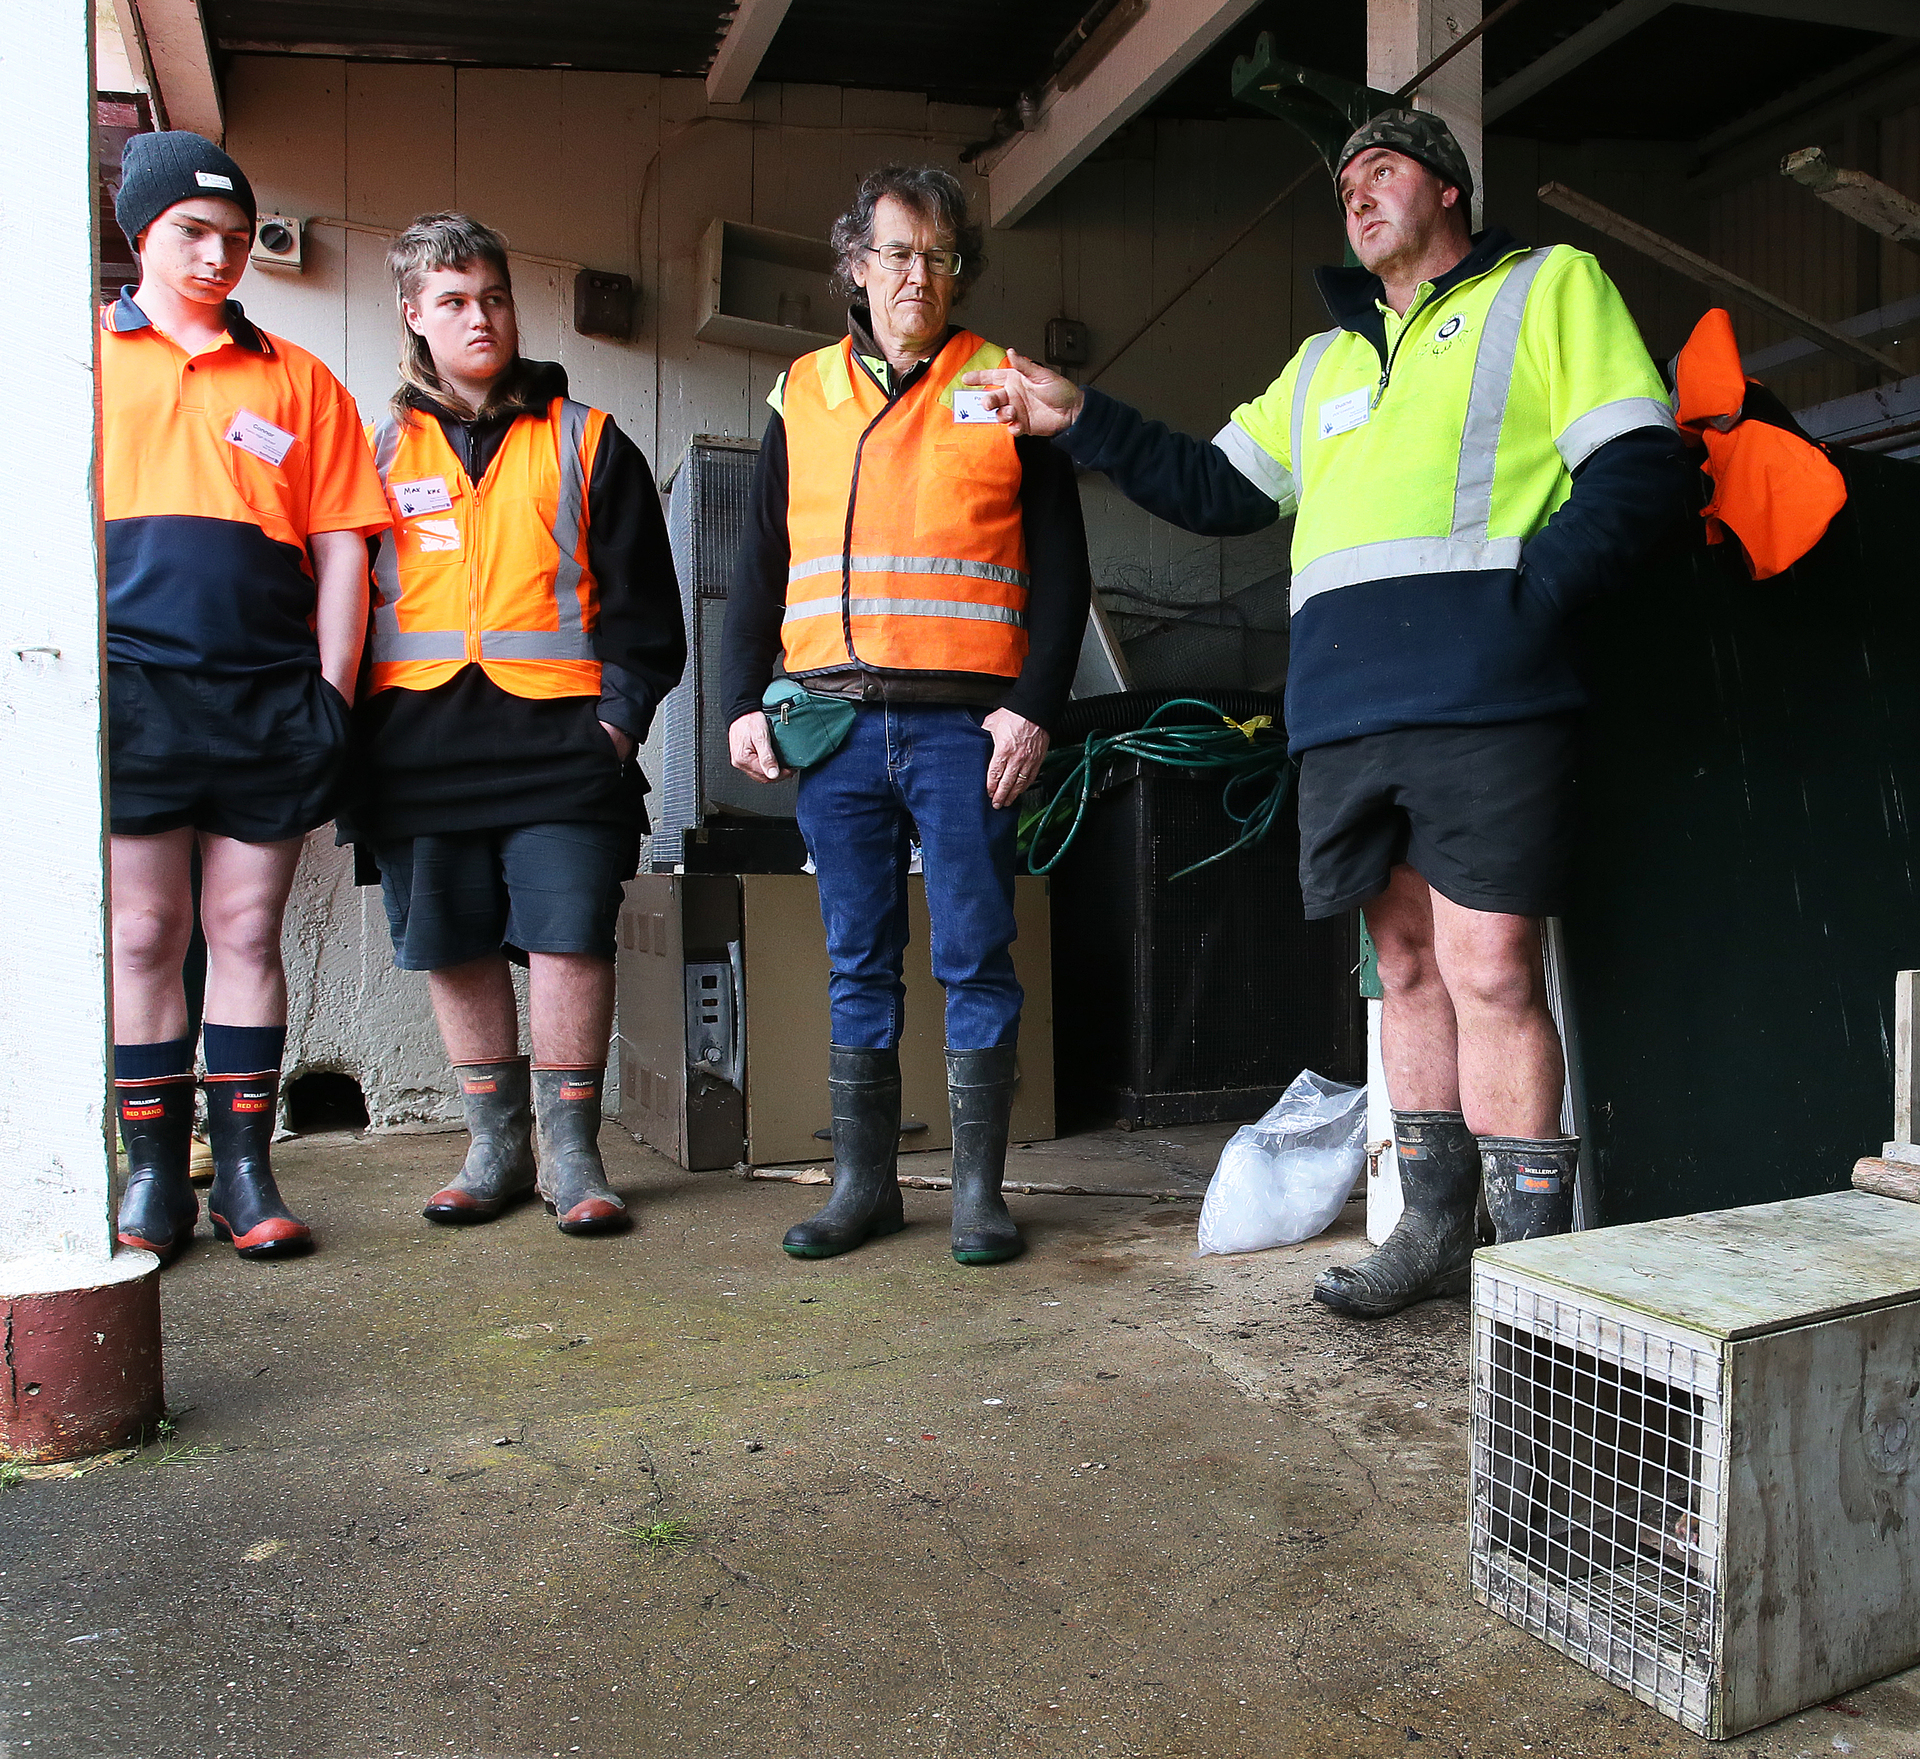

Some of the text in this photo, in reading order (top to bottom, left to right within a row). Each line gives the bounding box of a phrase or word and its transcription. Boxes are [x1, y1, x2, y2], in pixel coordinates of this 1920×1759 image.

[252, 423, 275, 437] Connor
[141, 1108, 162, 1116] BAND
[1524, 1167, 1558, 1175] SKELLERUP
